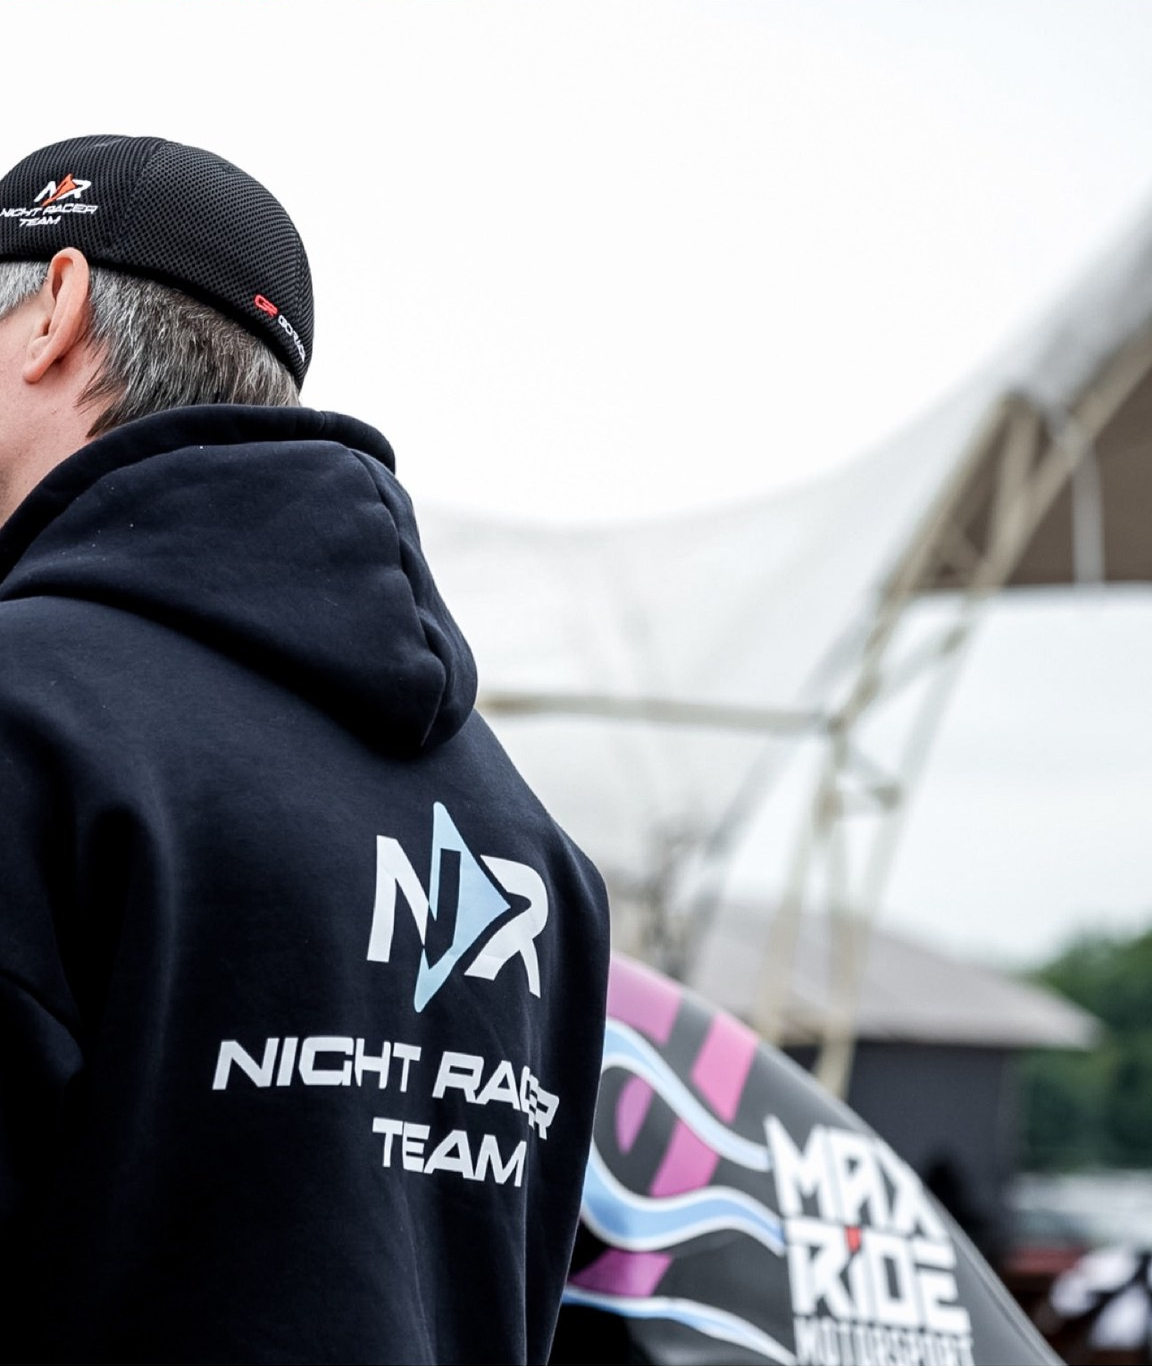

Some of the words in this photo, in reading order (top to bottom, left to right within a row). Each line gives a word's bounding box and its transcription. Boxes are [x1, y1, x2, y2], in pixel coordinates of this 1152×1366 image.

[19, 215, 62, 227] TEAM
[42, 203, 99, 215] RACER
[212, 1037, 422, 1093] NIGHT
[372, 1117, 527, 1187] TEAM
[763, 1114, 946, 1241] MAX
